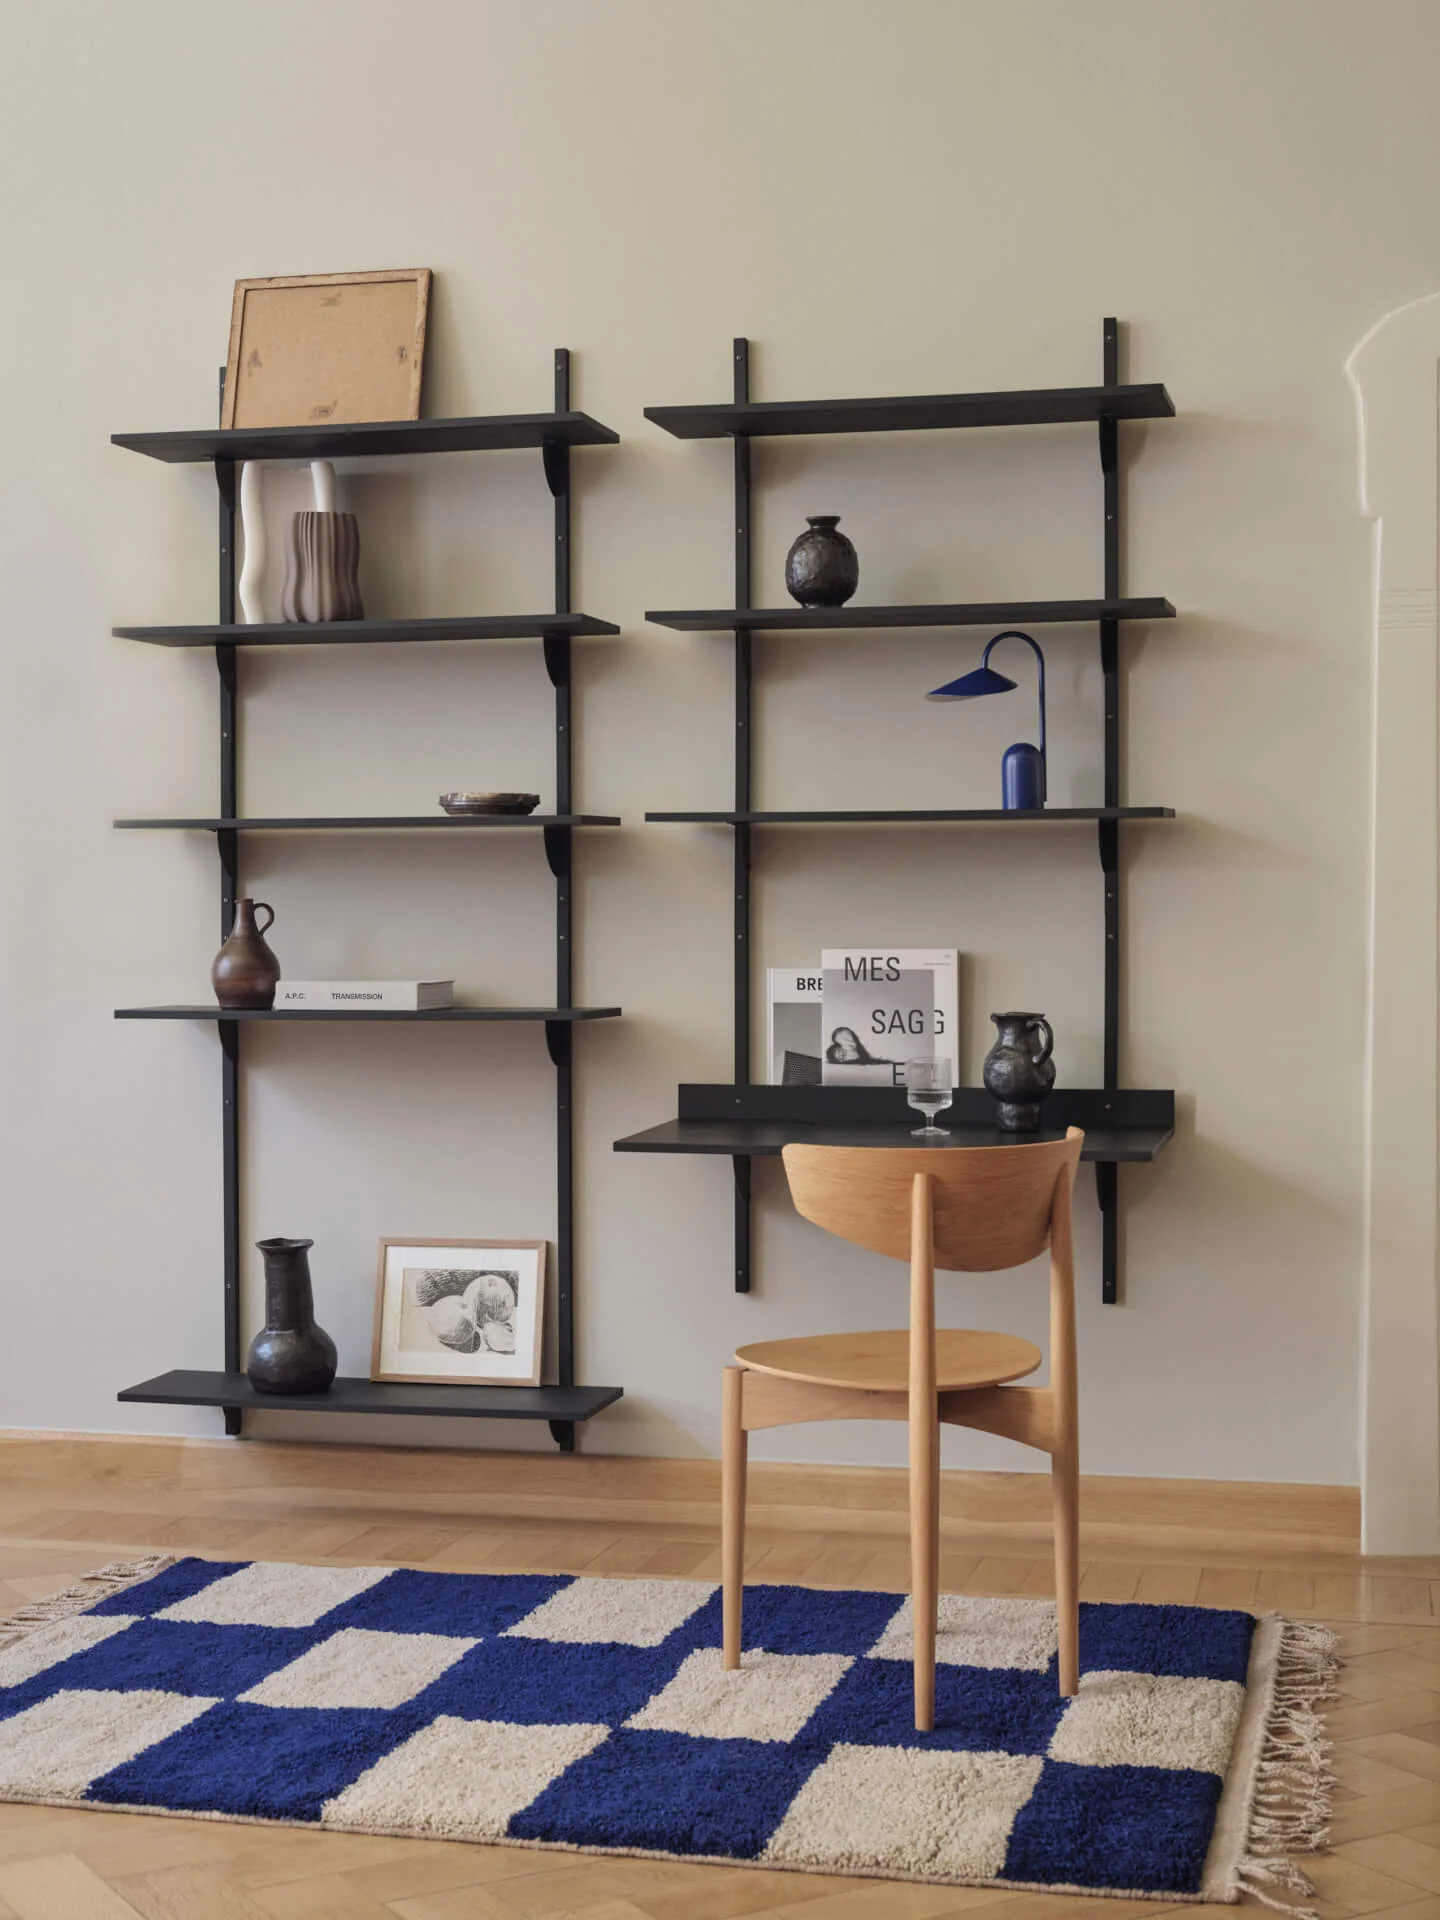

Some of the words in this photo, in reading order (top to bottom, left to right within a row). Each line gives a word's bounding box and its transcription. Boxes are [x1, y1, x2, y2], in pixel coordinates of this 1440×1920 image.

[844, 957, 901, 982] MES
[285, 992, 306, 1000] A.P.C.
[331, 992, 383, 1000] TRANSMISSION
[893, 1062, 906, 1086] E
